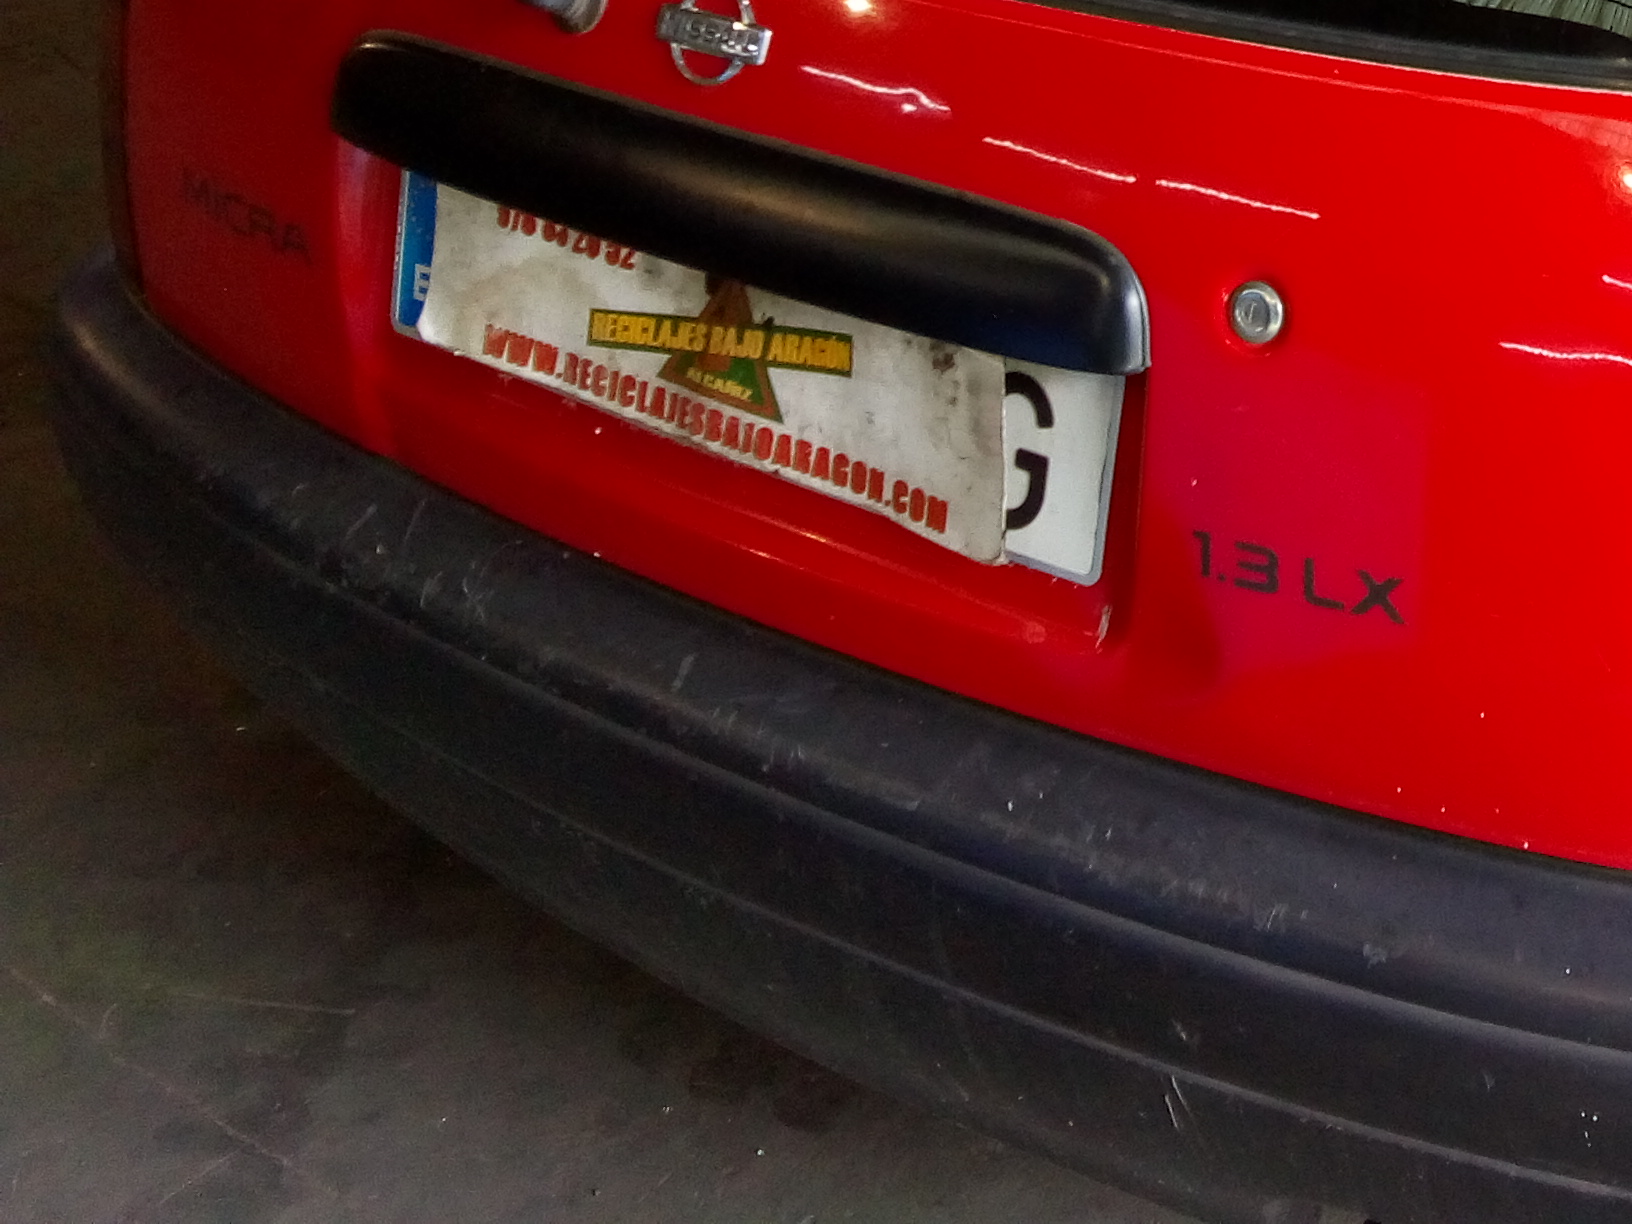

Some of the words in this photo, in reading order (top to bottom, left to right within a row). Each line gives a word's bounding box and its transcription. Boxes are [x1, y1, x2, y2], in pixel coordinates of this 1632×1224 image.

[182, 165, 312, 266] MICRA
[592, 310, 708, 353] RECICLAJES
[709, 325, 765, 360] BAJO
[1193, 529, 1279, 594] 1.3
[1304, 557, 1405, 625] LX
